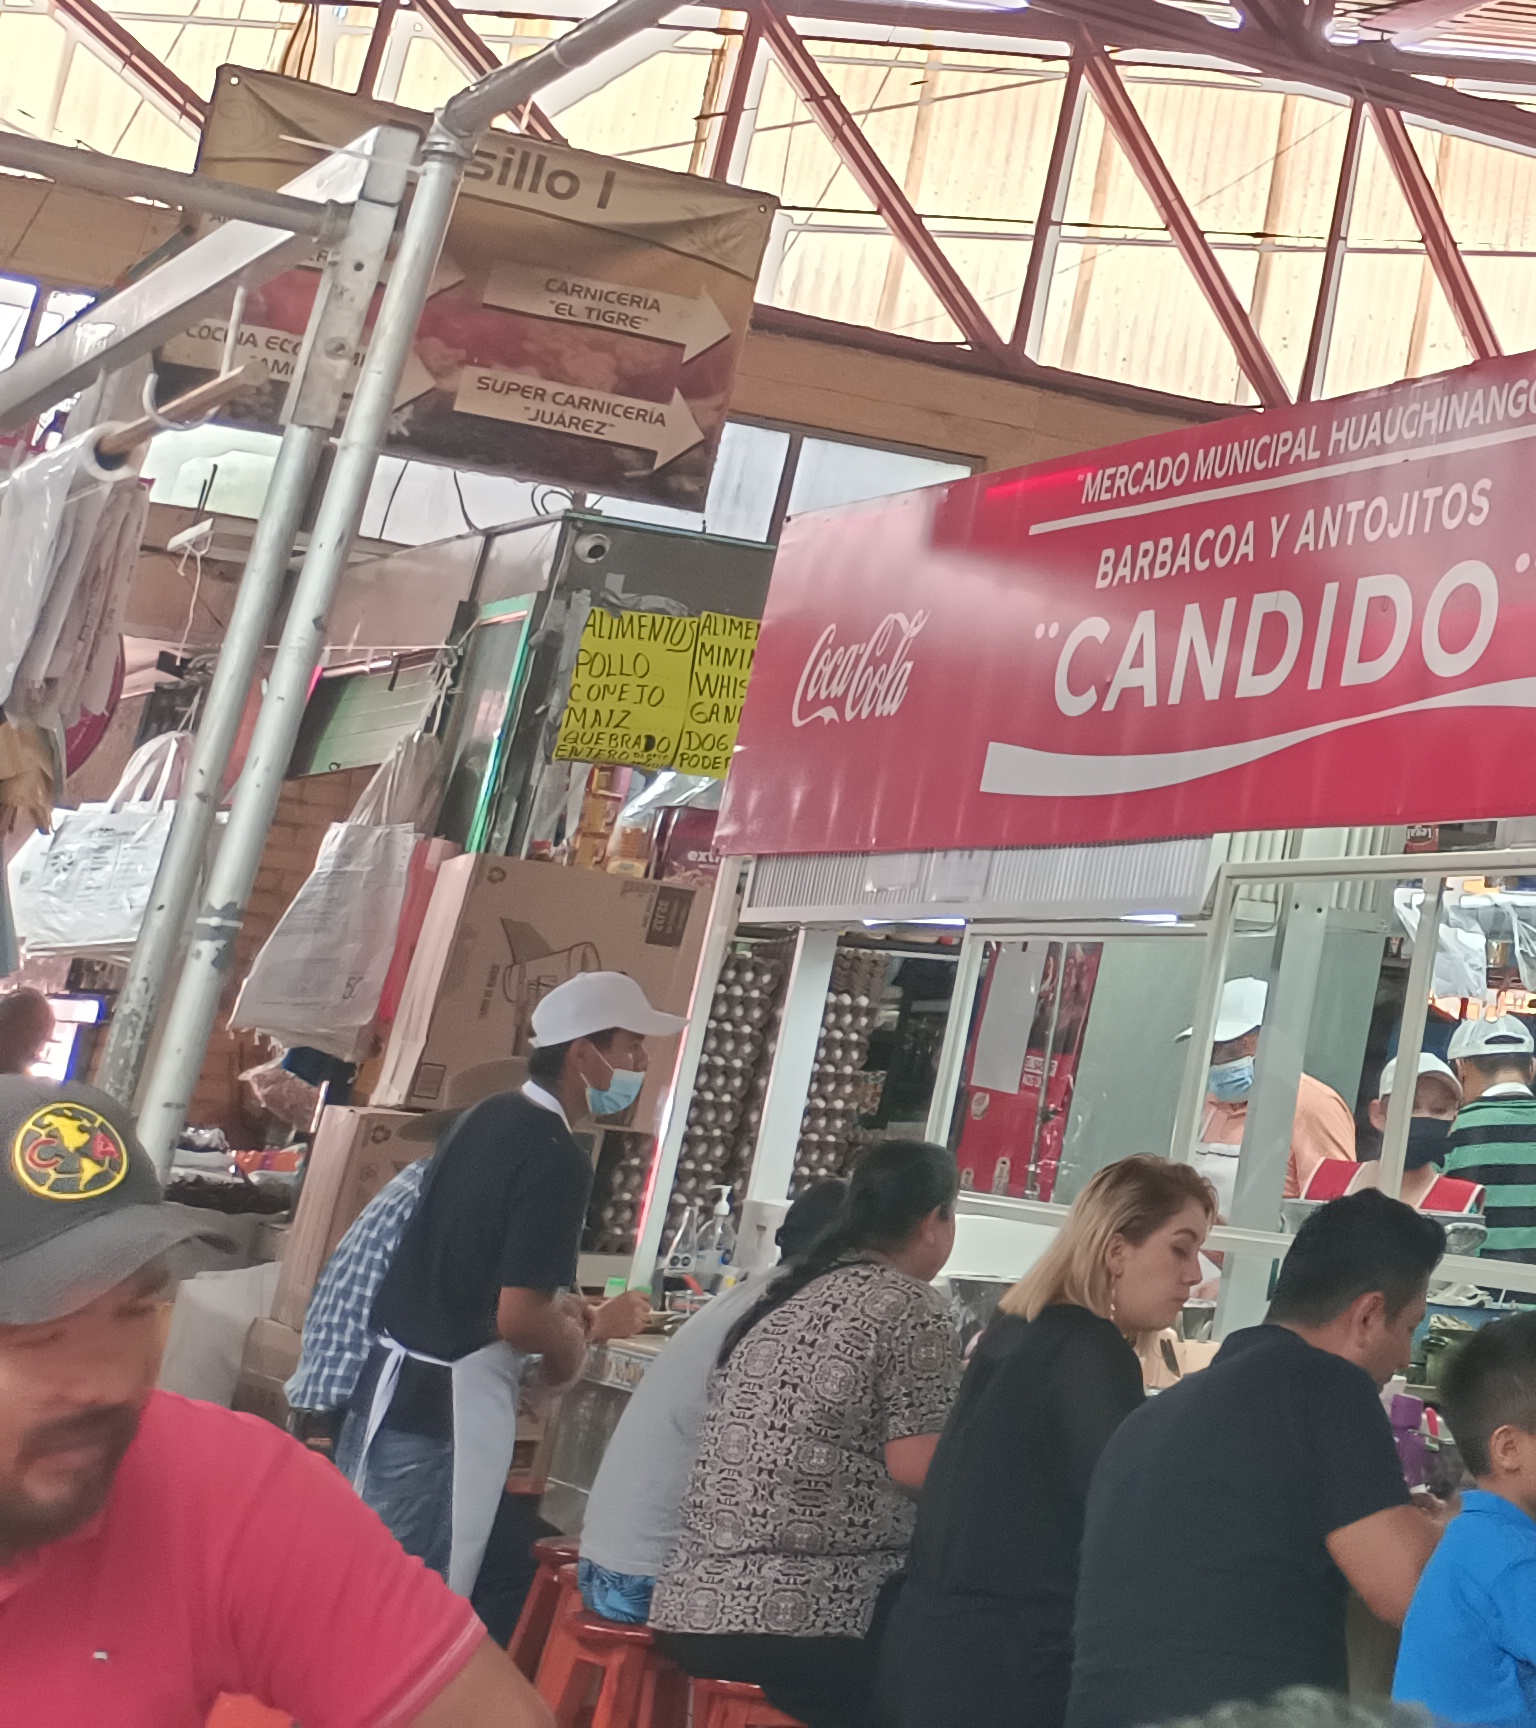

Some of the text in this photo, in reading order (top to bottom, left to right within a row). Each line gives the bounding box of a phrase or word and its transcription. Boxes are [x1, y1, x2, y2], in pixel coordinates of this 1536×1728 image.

[463, 145, 581, 201] sillo
[584, 306, 649, 330] TIGRE"
[476, 375, 547, 403] SUPER
[1077, 451, 1190, 504] "MERCADO
[1192, 425, 1320, 483] MUNICIPAL
[1094, 477, 1493, 590] BARBACOA Y ANTOJITOS
[584, 609, 696, 653] ALIMENTOS
[575, 648, 650, 679] POLLO
[790, 608, 931, 728] Coca-Cola
[569, 682, 665, 708] CONEJO
[695, 672, 748, 699] WHIS
[564, 706, 632, 730] MAIZ
[554, 744, 629, 761] ENTERO
[563, 730, 671, 754] QUEBRADO
[685, 730, 729, 752] DOG
